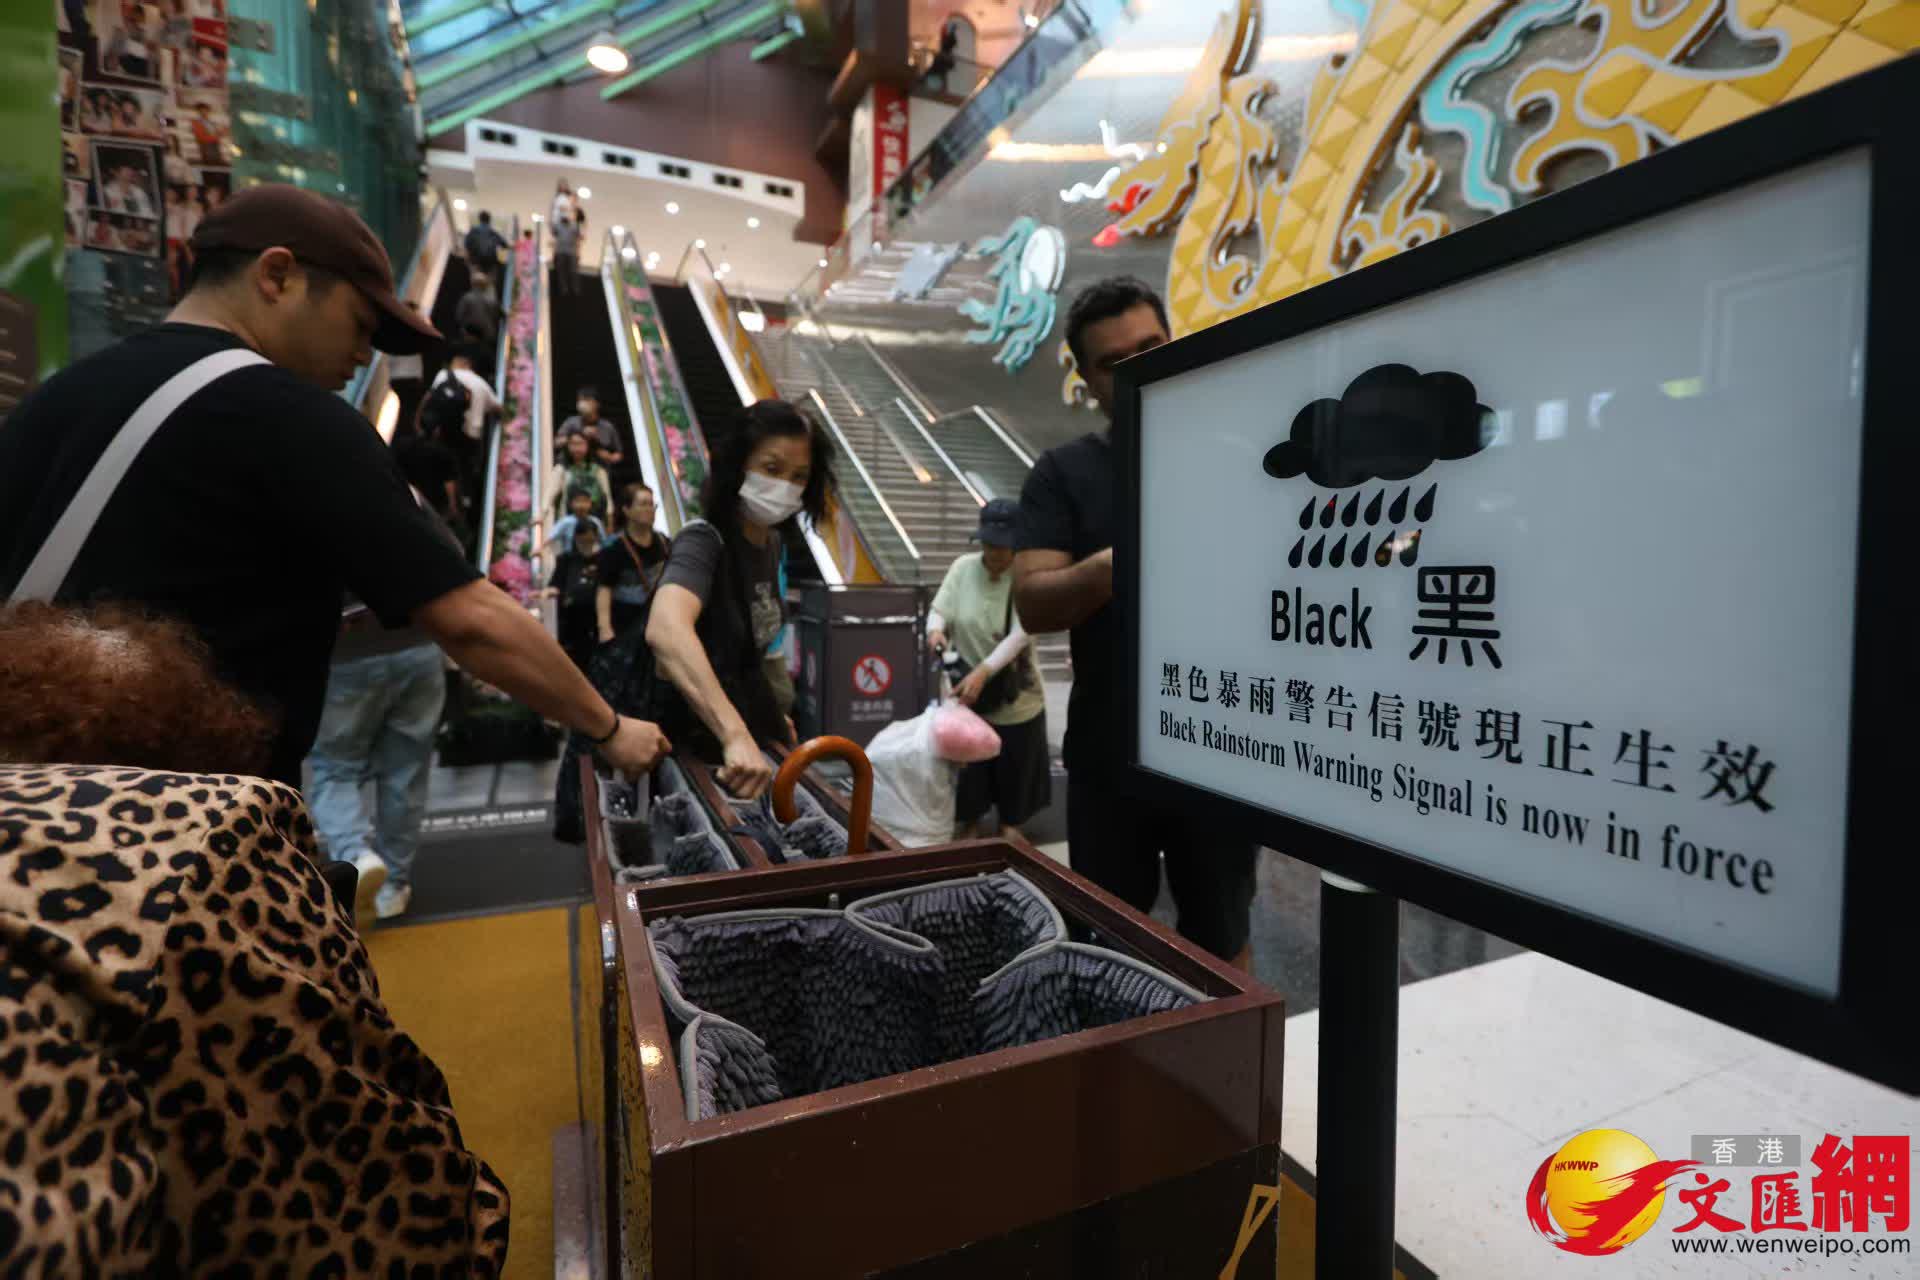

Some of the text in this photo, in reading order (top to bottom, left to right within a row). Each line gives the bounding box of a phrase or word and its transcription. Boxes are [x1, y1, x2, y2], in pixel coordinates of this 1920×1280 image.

[1271, 587, 1373, 649] Black
[1409, 565, 1502, 669] 黑
[1160, 662, 1776, 814] 黑色暴雨警告信號現正生效
[1160, 710, 1775, 895] Black Rainstorm Warning Signal is now in force
